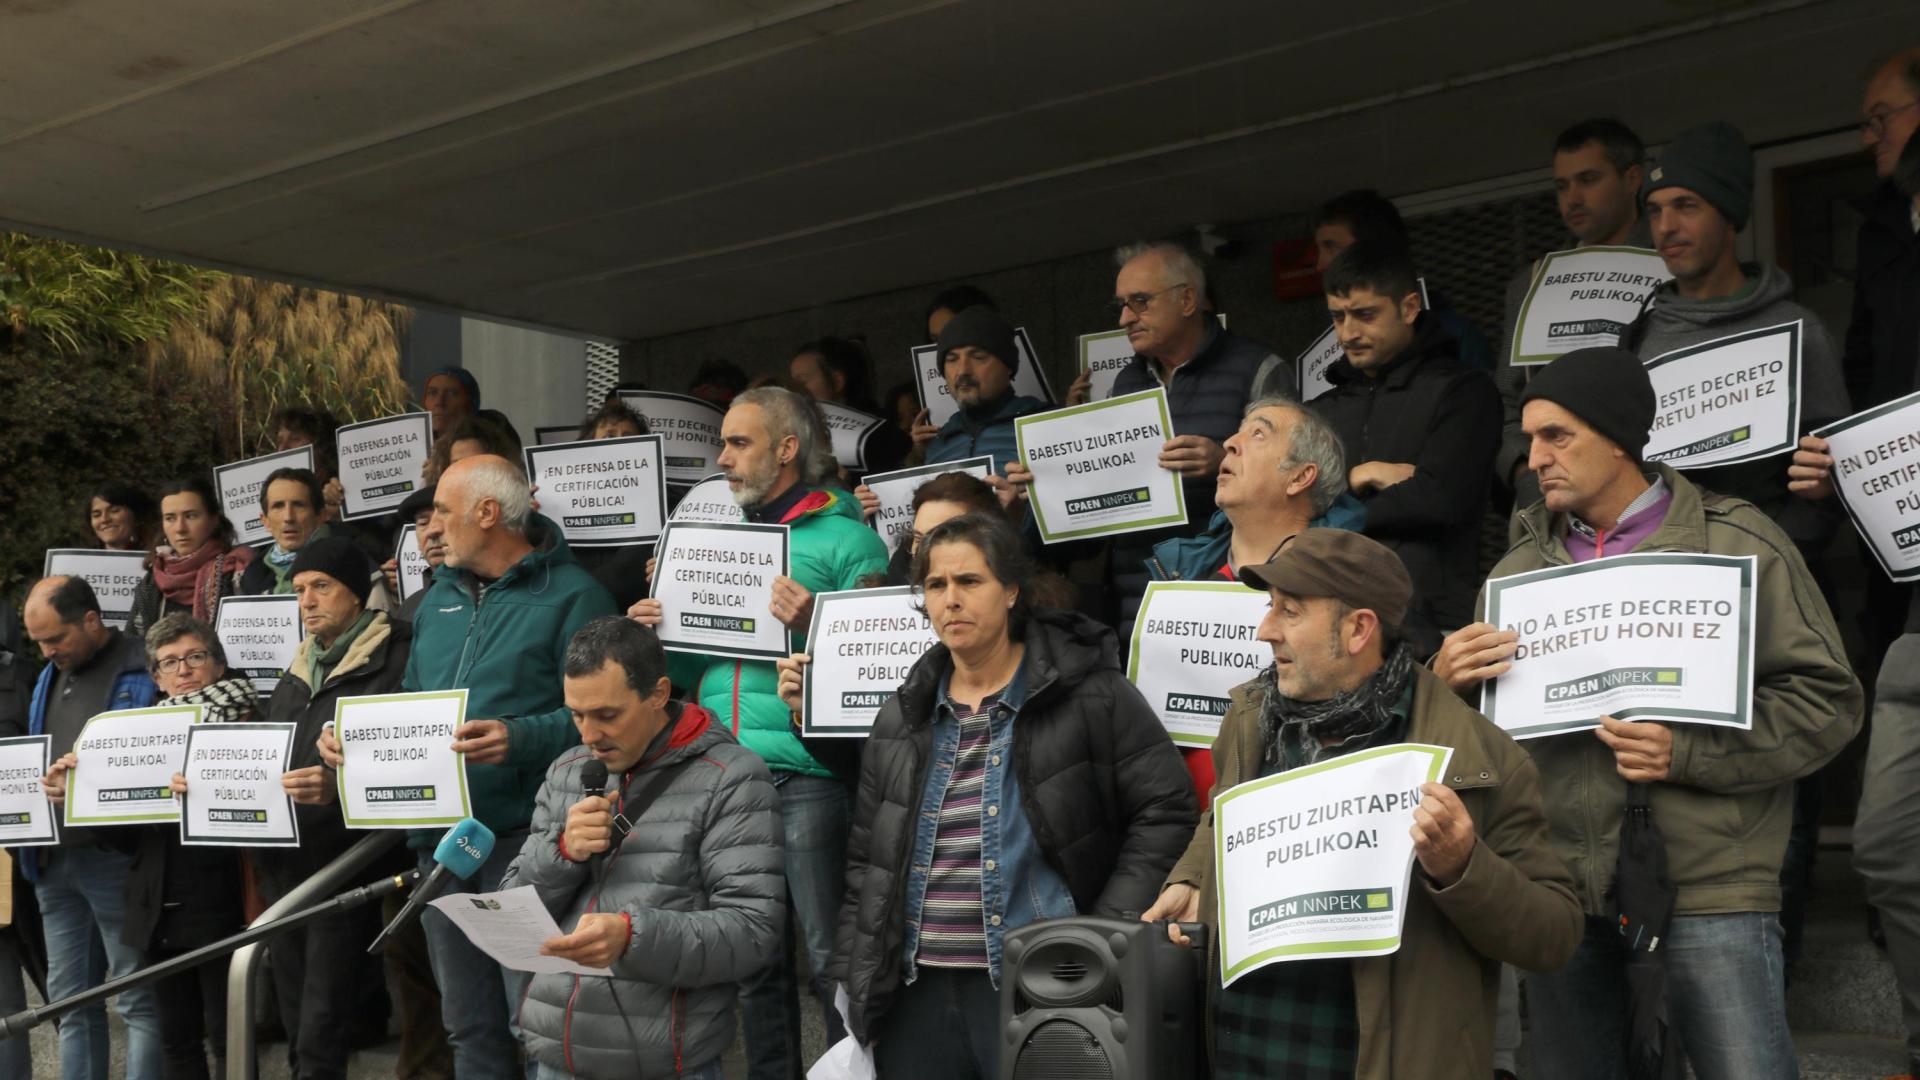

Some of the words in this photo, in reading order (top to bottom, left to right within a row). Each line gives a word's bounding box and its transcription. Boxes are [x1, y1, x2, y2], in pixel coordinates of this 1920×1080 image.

[1544, 271, 1605, 286] BABESTU
[1606, 272, 1662, 288] ZIURTA
[1570, 289, 1645, 305] PUBLIKOA
[1551, 324, 1584, 335] CPAEN
[1586, 321, 1621, 333] NNPEK
[1092, 357, 1132, 372] BABES
[1660, 384, 1696, 408] ESTE
[1701, 360, 1783, 394] DECRETO
[1650, 404, 1696, 432] RETU
[1701, 387, 1749, 414] HONI
[1756, 379, 1776, 398] EZ
[650, 417, 675, 429] ESTE
[677, 420, 723, 437] DECRET
[353, 438, 390, 453] DEFENSA
[392, 434, 404, 446] DE
[406, 432, 418, 443] LA
[676, 432, 708, 444] HONI
[1030, 440, 1083, 461] BABESTU
[1085, 424, 1160, 450] ZIURTAPEN
[1691, 433, 1731, 453] NNPEK
[349, 447, 412, 470] CERTIFICACIÓN
[1839, 454, 1863, 479] ¡EN
[1864, 429, 1920, 466] DEFEN
[544, 466, 562, 479] ¡EN
[566, 461, 615, 475] DEFENSA
[617, 459, 631, 470] DE
[634, 458, 649, 469] LA
[1066, 451, 1136, 475] PUBLIKOA!
[365, 466, 403, 481] PÚBLICA!
[225, 488, 238, 499] NO
[240, 486, 247, 494] A
[248, 480, 266, 493] EST
[554, 474, 639, 492] CERTIFICACIÓN
[229, 494, 261, 510] DEKRET
[571, 496, 625, 509] PÚBLICA!
[680, 504, 692, 514] NO
[694, 503, 700, 511] A
[703, 503, 726, 515] ESTE
[1068, 500, 1101, 514] CPAEN
[1102, 492, 1136, 507] NNPEK
[879, 508, 895, 520] NO
[898, 506, 904, 516] A
[565, 518, 592, 527] CPAEN
[1895, 526, 1920, 546] CPA
[403, 552, 417, 562] NO
[670, 547, 686, 562] ¡EN
[688, 549, 737, 564] DEFENSA
[740, 552, 756, 565] DE
[759, 554, 774, 566] LA
[675, 569, 763, 588] CERTIFICACIÓN
[692, 590, 745, 608] PÚBLICA!
[232, 617, 266, 628] DEFENSA
[267, 617, 279, 628] DE
[281, 617, 292, 628] LA
[682, 615, 711, 627] CPAEN
[713, 618, 741, 630] NNPEK
[827, 620, 850, 636] ¡EN
[854, 617, 917, 632] DEFENSA
[921, 618, 931, 630] D
[1507, 619, 1537, 636] NO
[1544, 613, 1557, 631] A
[1564, 603, 1613, 626] ESTE
[1620, 600, 1732, 617] DECRETO
[1147, 619, 1209, 637] BABESTU
[1213, 623, 1257, 641] ZIURT
[837, 637, 935, 656] CERTIFICACIÓ
[1514, 625, 1609, 661] DEKRETU
[1618, 622, 1683, 639] HONI
[1693, 623, 1721, 639] EZ
[1181, 648, 1259, 669] PUBLIKOA!
[858, 663, 908, 680] PÚBLIC
[1549, 678, 1599, 700] CPAEN
[1601, 671, 1652, 689] NNPEK
[843, 695, 879, 706] CPAEN
[1169, 697, 1210, 712] CPAEN
[344, 727, 390, 742] BABESTU
[393, 724, 453, 739] ZIURTAPEN
[81, 737, 128, 751] BABESTU
[107, 753, 167, 767] PUBLIKOA!
[210, 749, 249, 760] DEFENSA
[252, 749, 264, 760] DE
[266, 749, 277, 760] LA
[373, 747, 428, 762] PUBLIKOA!
[0, 767, 40, 781] DECRETO
[200, 766, 268, 781] CERTIFICACIÓN
[0, 782, 24, 795] HONI
[28, 781, 40, 793] EZ
[99, 791, 129, 801] CPAEN
[131, 789, 159, 799] NNPEK
[214, 785, 256, 801] PÚBLICA!
[366, 790, 394, 800] CPAEN
[395, 788, 421, 799] NNPEK
[209, 811, 233, 821] CPAEN
[1227, 813, 1301, 853] BABESTU
[1307, 787, 1420, 826] ZIURTAPEN
[465, 845, 481, 860] eitb
[1266, 830, 1378, 867] PUBLIKOA!
[1251, 903, 1297, 926] CPAEN
[1303, 895, 1361, 913] NNPEK
